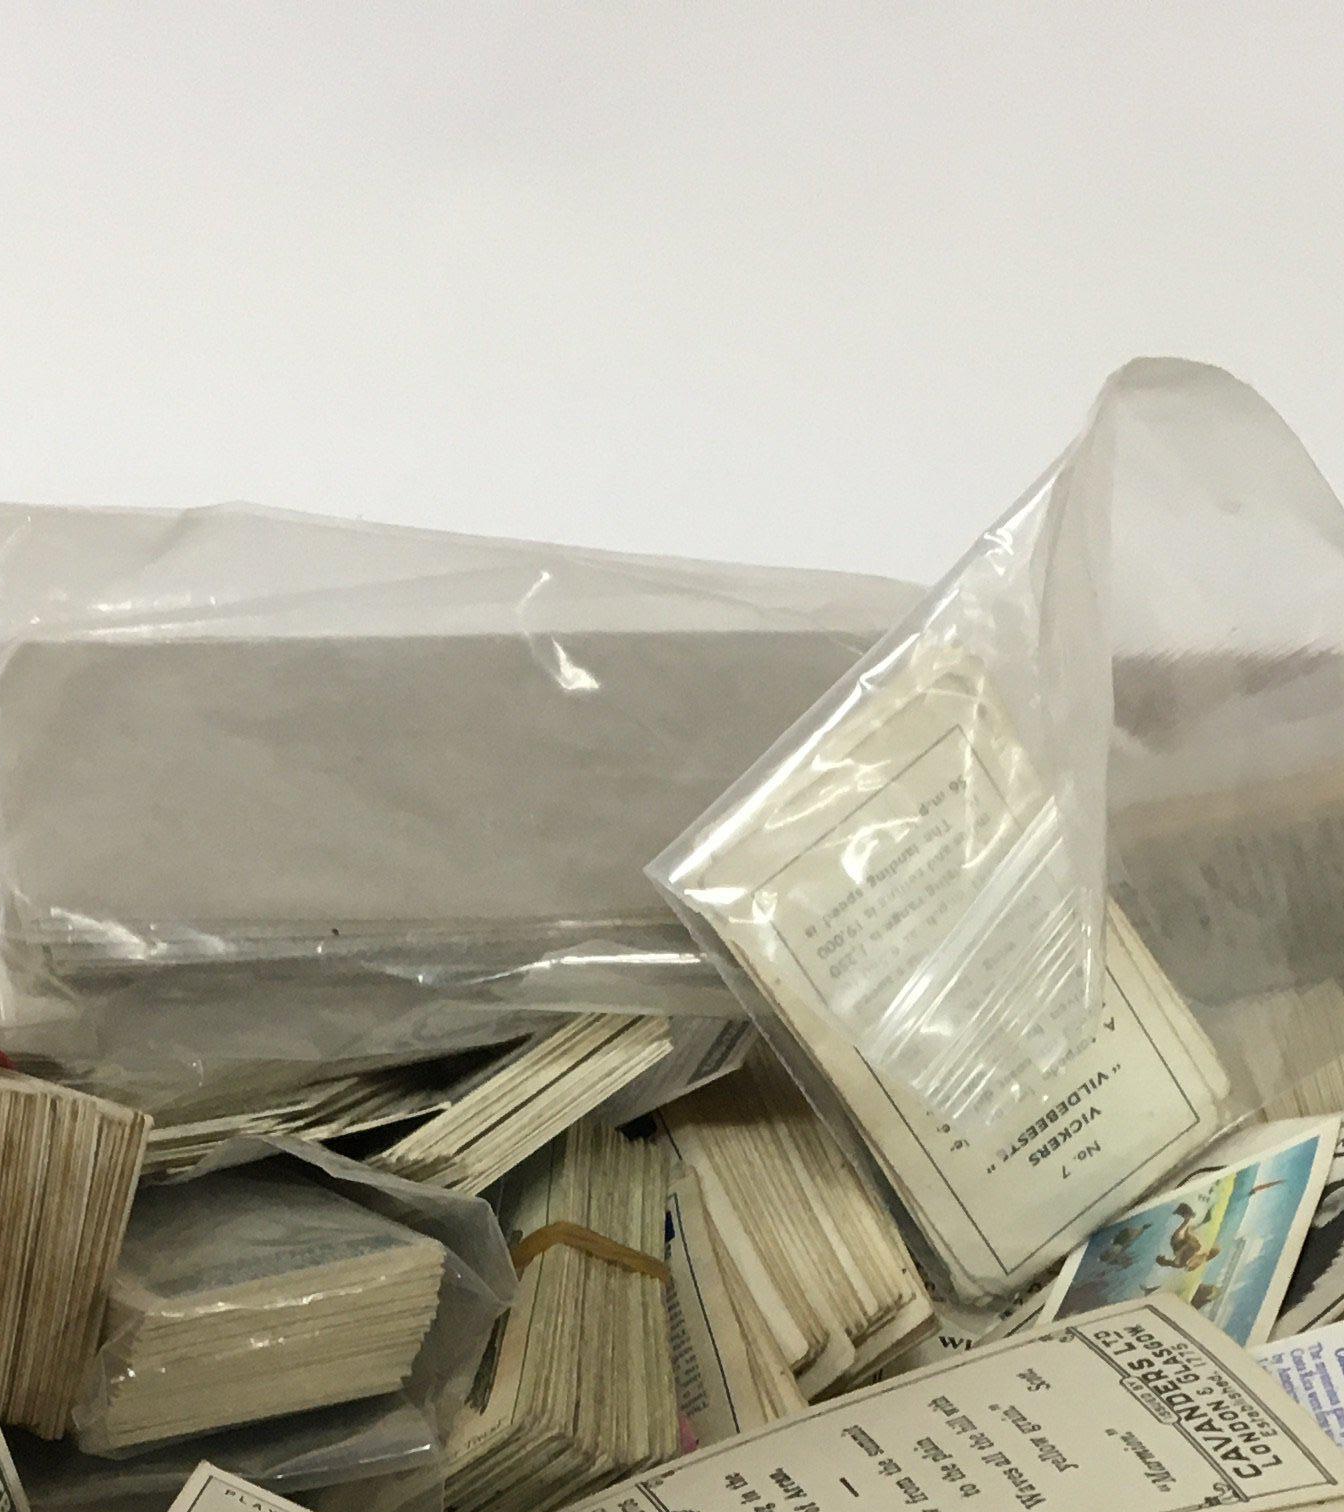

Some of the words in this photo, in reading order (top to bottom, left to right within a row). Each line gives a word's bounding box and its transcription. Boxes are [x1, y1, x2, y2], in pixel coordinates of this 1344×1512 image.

[1025, 1103, 1102, 1168] VICKERS
[1071, 1138, 1103, 1167] No.
[1055, 1163, 1071, 1180] 7
[1171, 1337, 1206, 1372] 1775
[1195, 1382, 1214, 1400] &
[944, 1408, 978, 1441] hill
[1127, 1351, 1263, 1486] CAVANDERS
[1206, 1393, 1282, 1474] LONDON
[911, 1429, 953, 1472] plain
[964, 1426, 995, 1457] the
[1027, 1425, 1078, 1482] yellow
[873, 1454, 901, 1482] the
[935, 1457, 965, 1488] the
[980, 1444, 1012, 1475] all
[720, 1467, 748, 1495] the
[892, 1471, 929, 1511] from
[956, 1479, 980, 1502] to
[999, 1460, 1045, 1512] Waves
[737, 1486, 761, 1509] in
